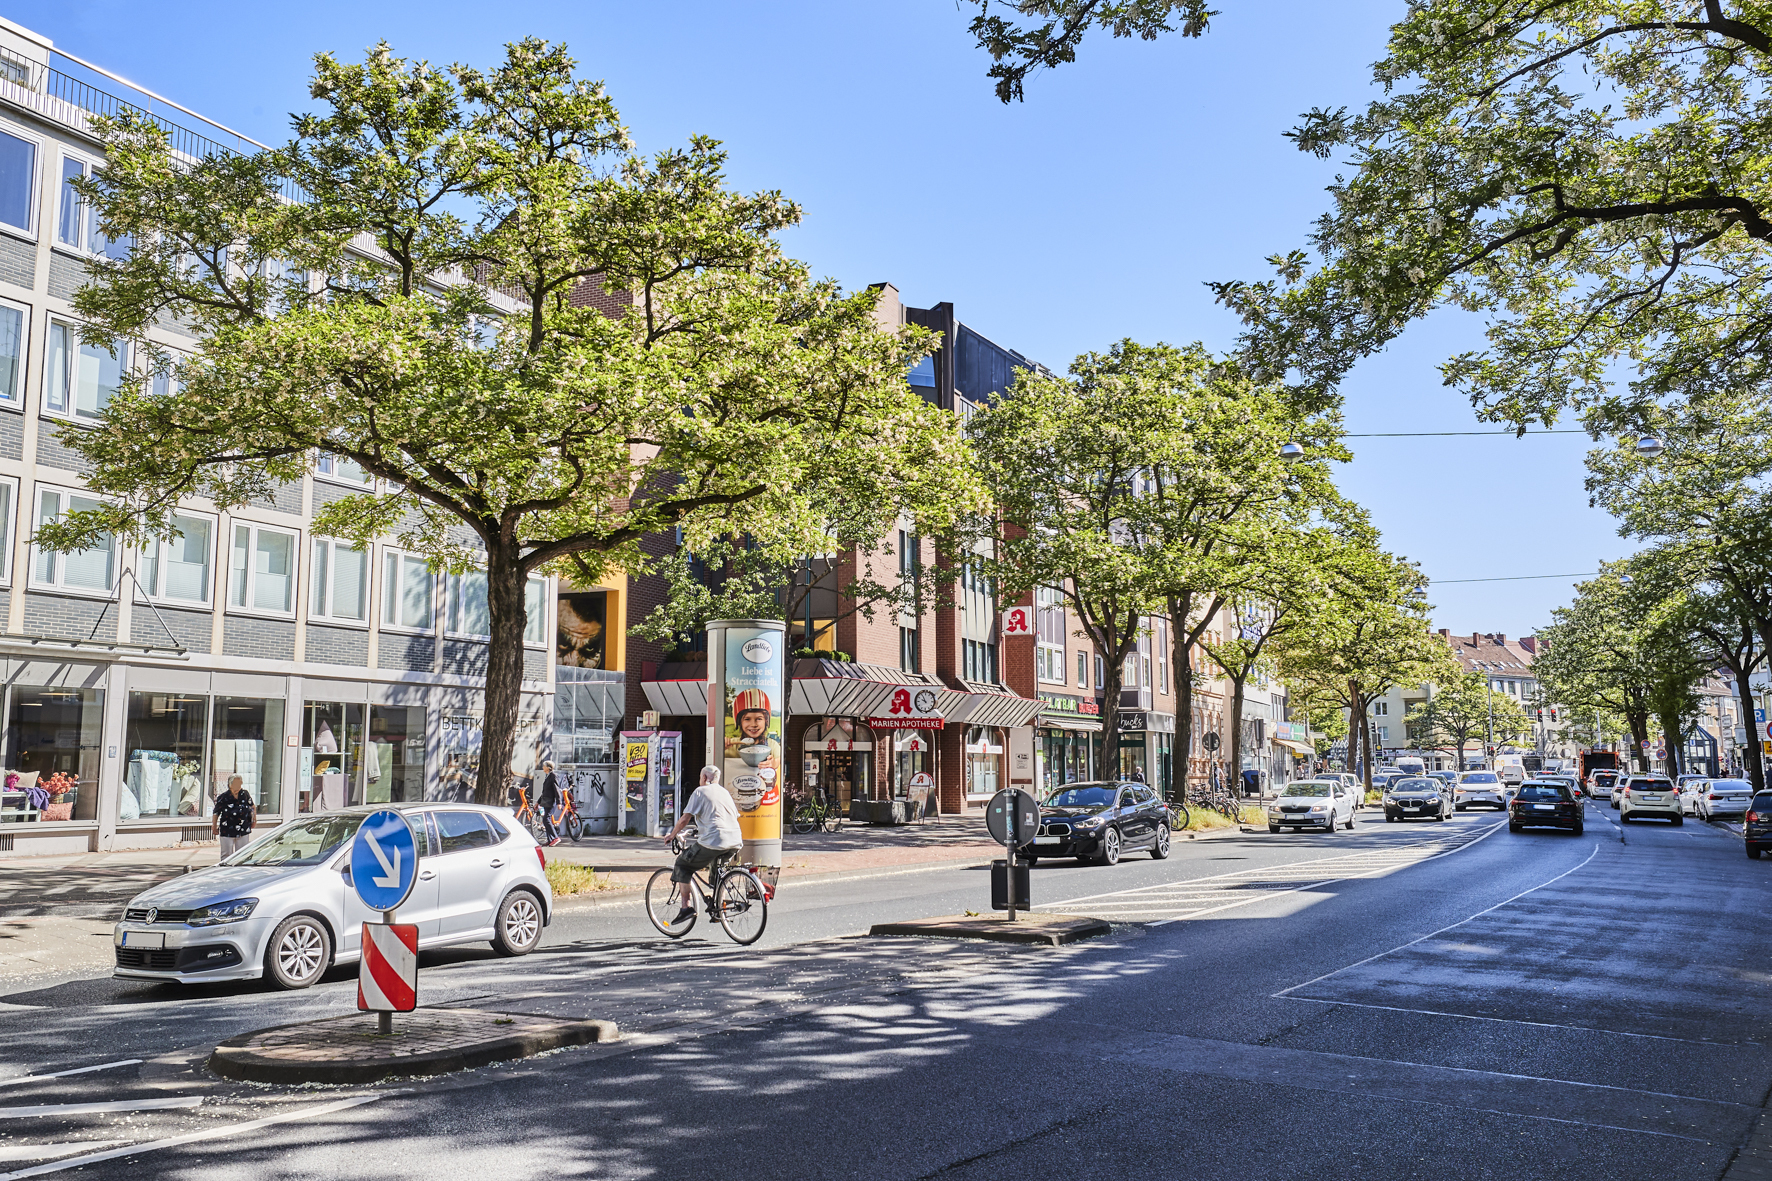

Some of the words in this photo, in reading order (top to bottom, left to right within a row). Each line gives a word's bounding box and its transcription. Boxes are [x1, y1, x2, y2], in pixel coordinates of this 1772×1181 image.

[741, 666, 763, 676] Liebe
[764, 667, 773, 676] ist
[871, 720, 900, 728] MARIEN
[901, 720, 940, 728] APOTHEKE
